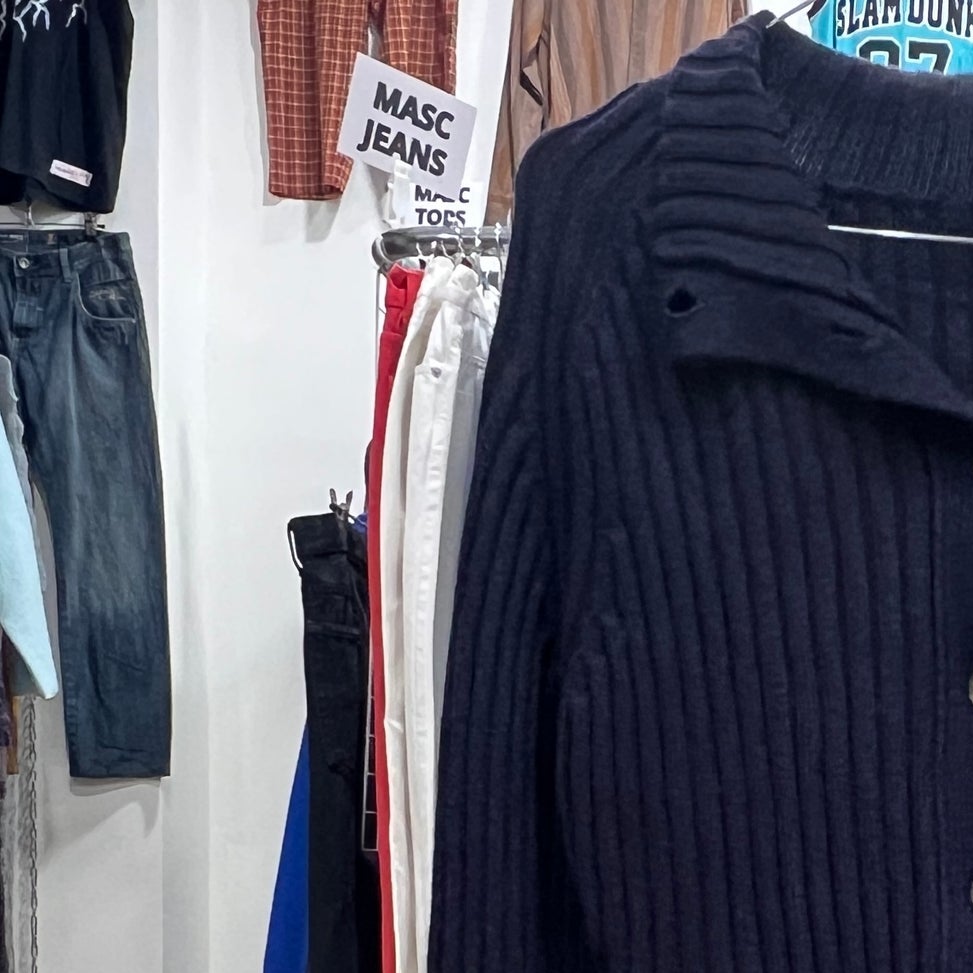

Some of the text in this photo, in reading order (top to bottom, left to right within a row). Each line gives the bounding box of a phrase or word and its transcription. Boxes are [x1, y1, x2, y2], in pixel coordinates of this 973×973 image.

[836, 0, 901, 38] SLAM
[373, 81, 455, 140] MASC
[356, 118, 448, 177] JEANS
[415, 208, 466, 227] TOPS
